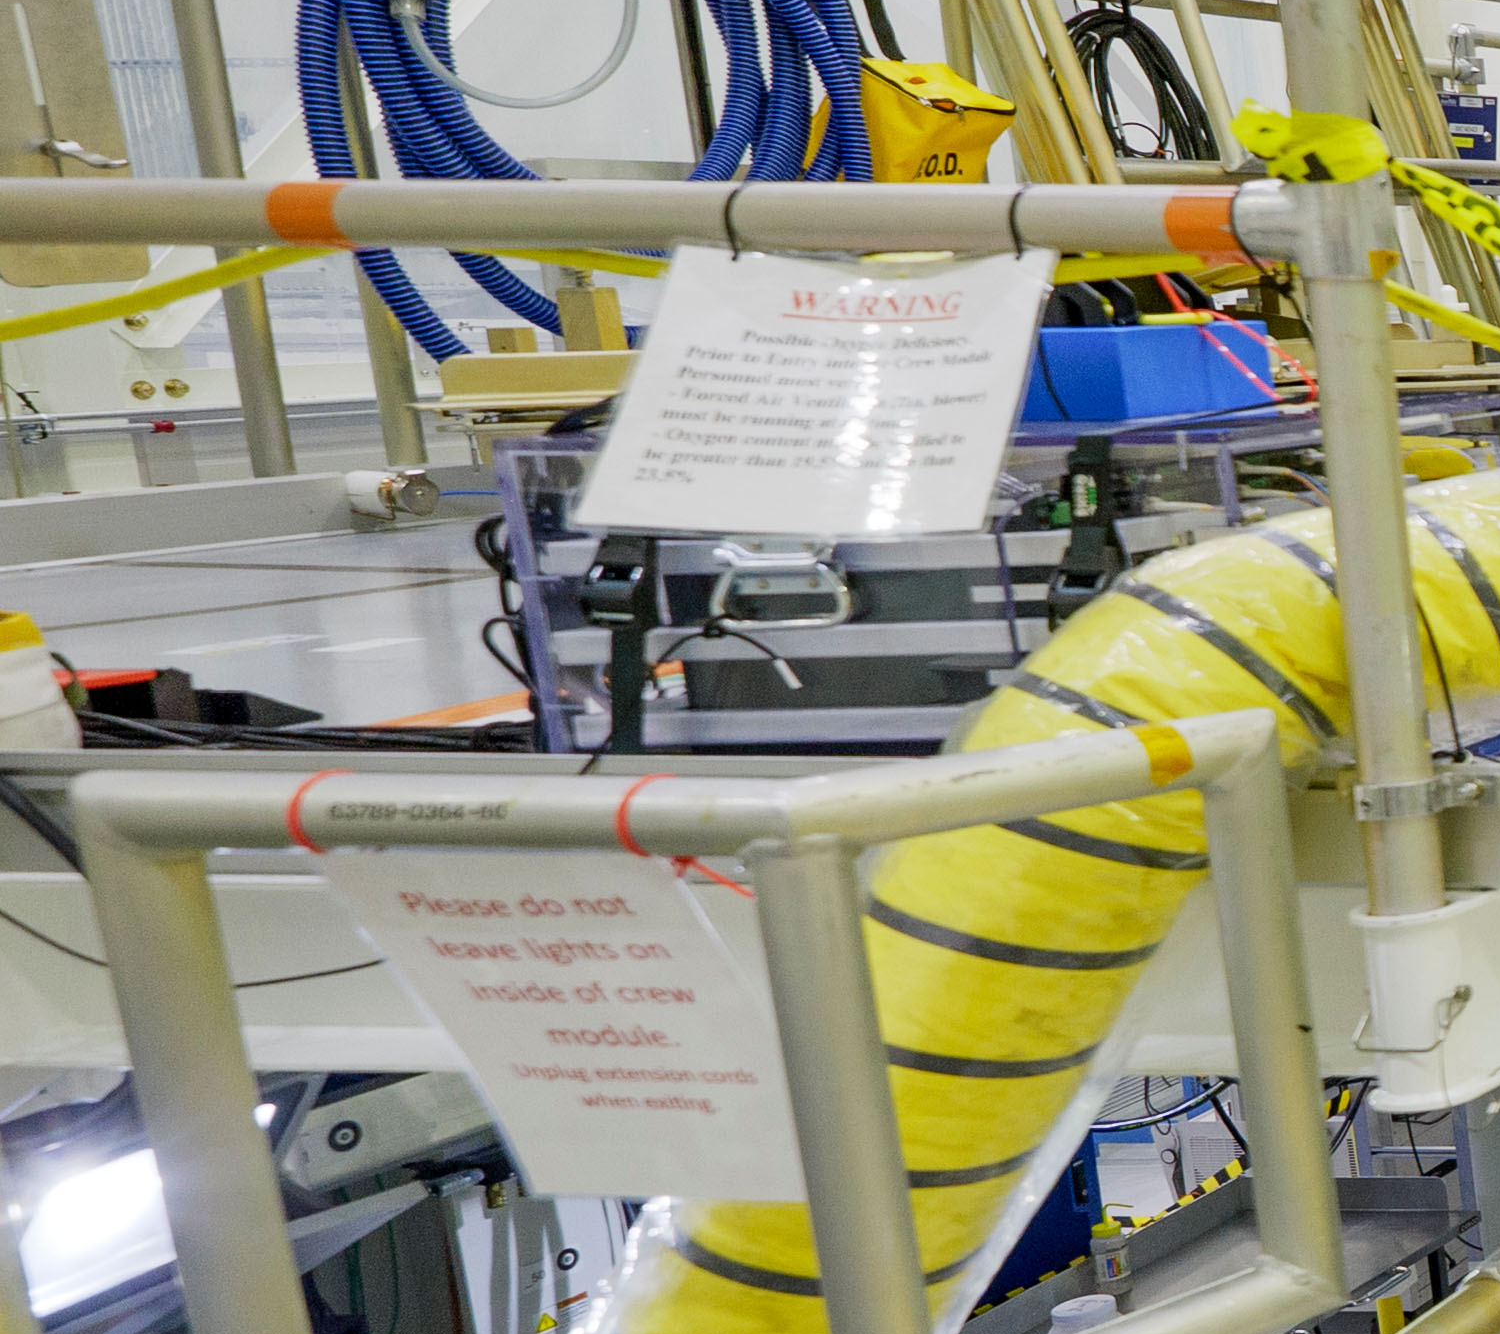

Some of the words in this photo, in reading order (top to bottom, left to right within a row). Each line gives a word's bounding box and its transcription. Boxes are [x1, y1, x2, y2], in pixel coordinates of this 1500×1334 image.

[790, 290, 963, 318] WARNING
[685, 345, 735, 363] Prior
[676, 365, 772, 385] Personnel
[681, 386, 750, 404] Forced
[397, 890, 513, 918] Please
[518, 890, 566, 917] do
[570, 893, 638, 917] not
[426, 936, 520, 962] leave
[520, 936, 621, 966] lights
[624, 942, 674, 961] on
[464, 978, 570, 1004] inside
[571, 979, 611, 1005] of
[614, 985, 696, 1005] crew
[545, 1022, 682, 1048] module.
[595, 1066, 699, 1083] extension
[699, 1067, 760, 1086] cords
